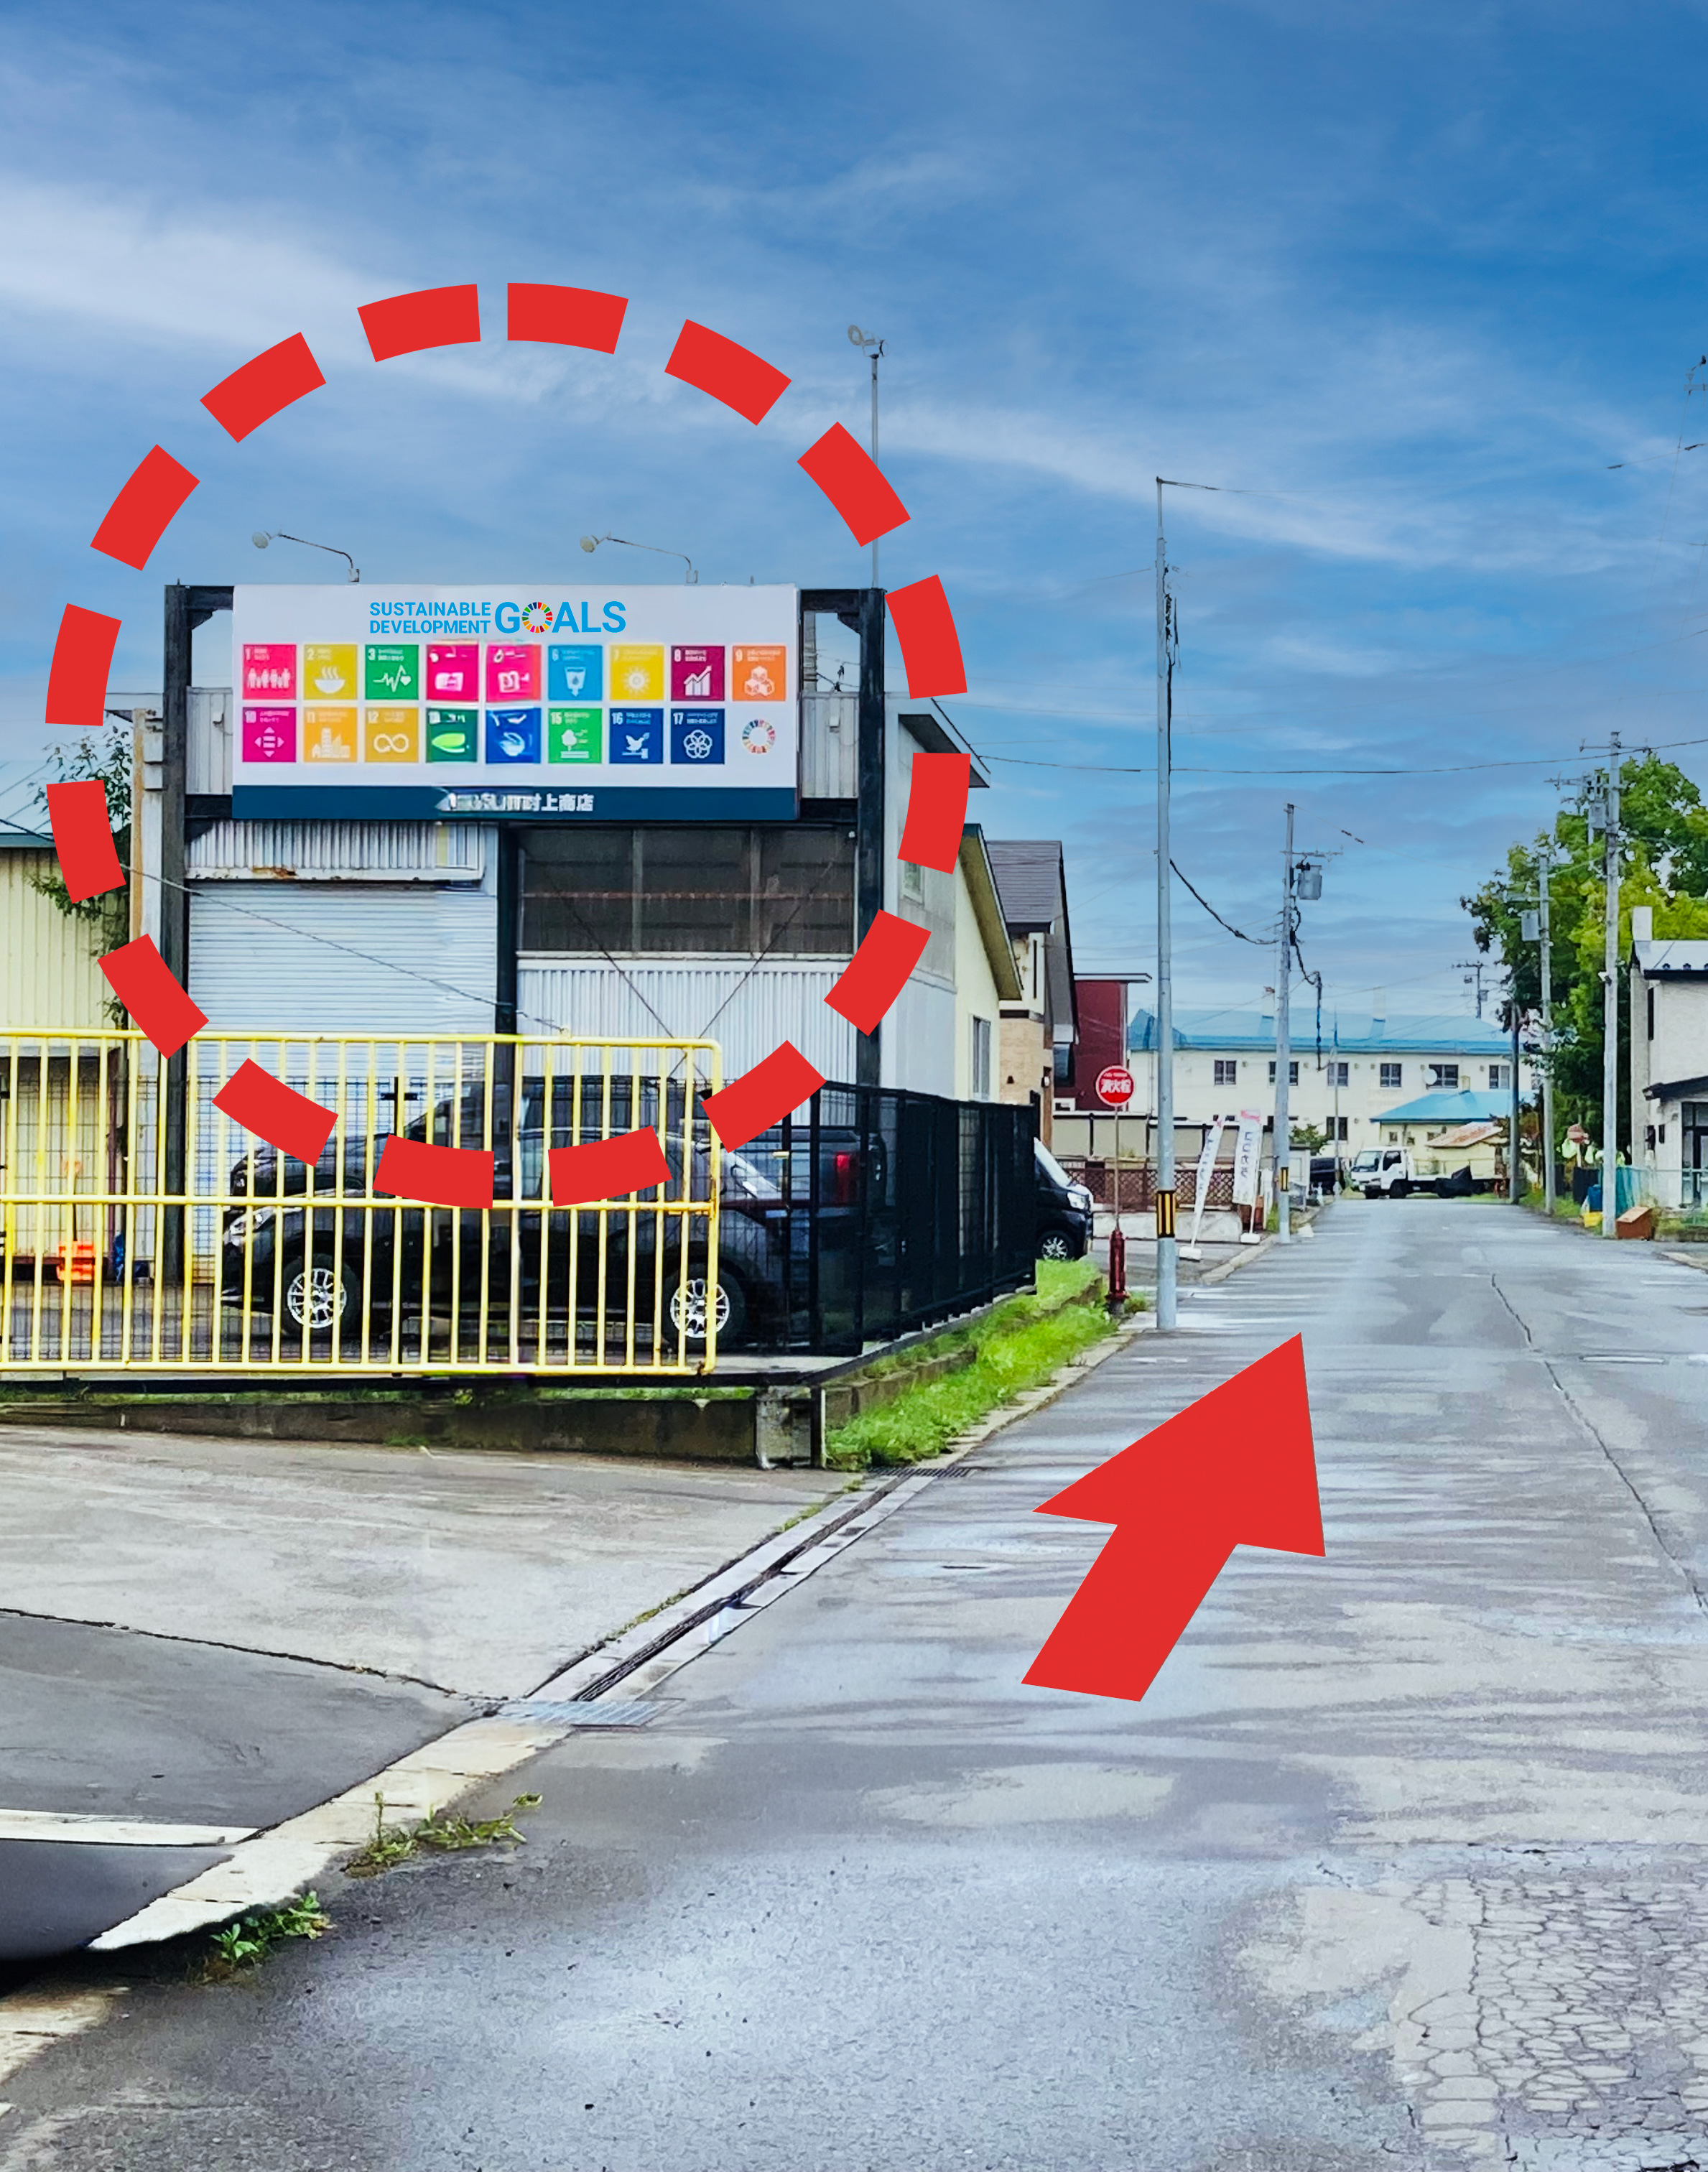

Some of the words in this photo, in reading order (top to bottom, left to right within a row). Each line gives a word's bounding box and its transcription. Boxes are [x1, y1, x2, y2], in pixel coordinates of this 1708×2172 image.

[369, 602, 491, 616] SUSTAINABLE
[494, 600, 626, 634] GOALS
[369, 620, 491, 634] DEVELOPMENT
[307, 648, 315, 661] 2
[368, 648, 376, 661] 3
[551, 712, 562, 725] 15
[612, 712, 623, 725] 16
[673, 712, 683, 725] 17
